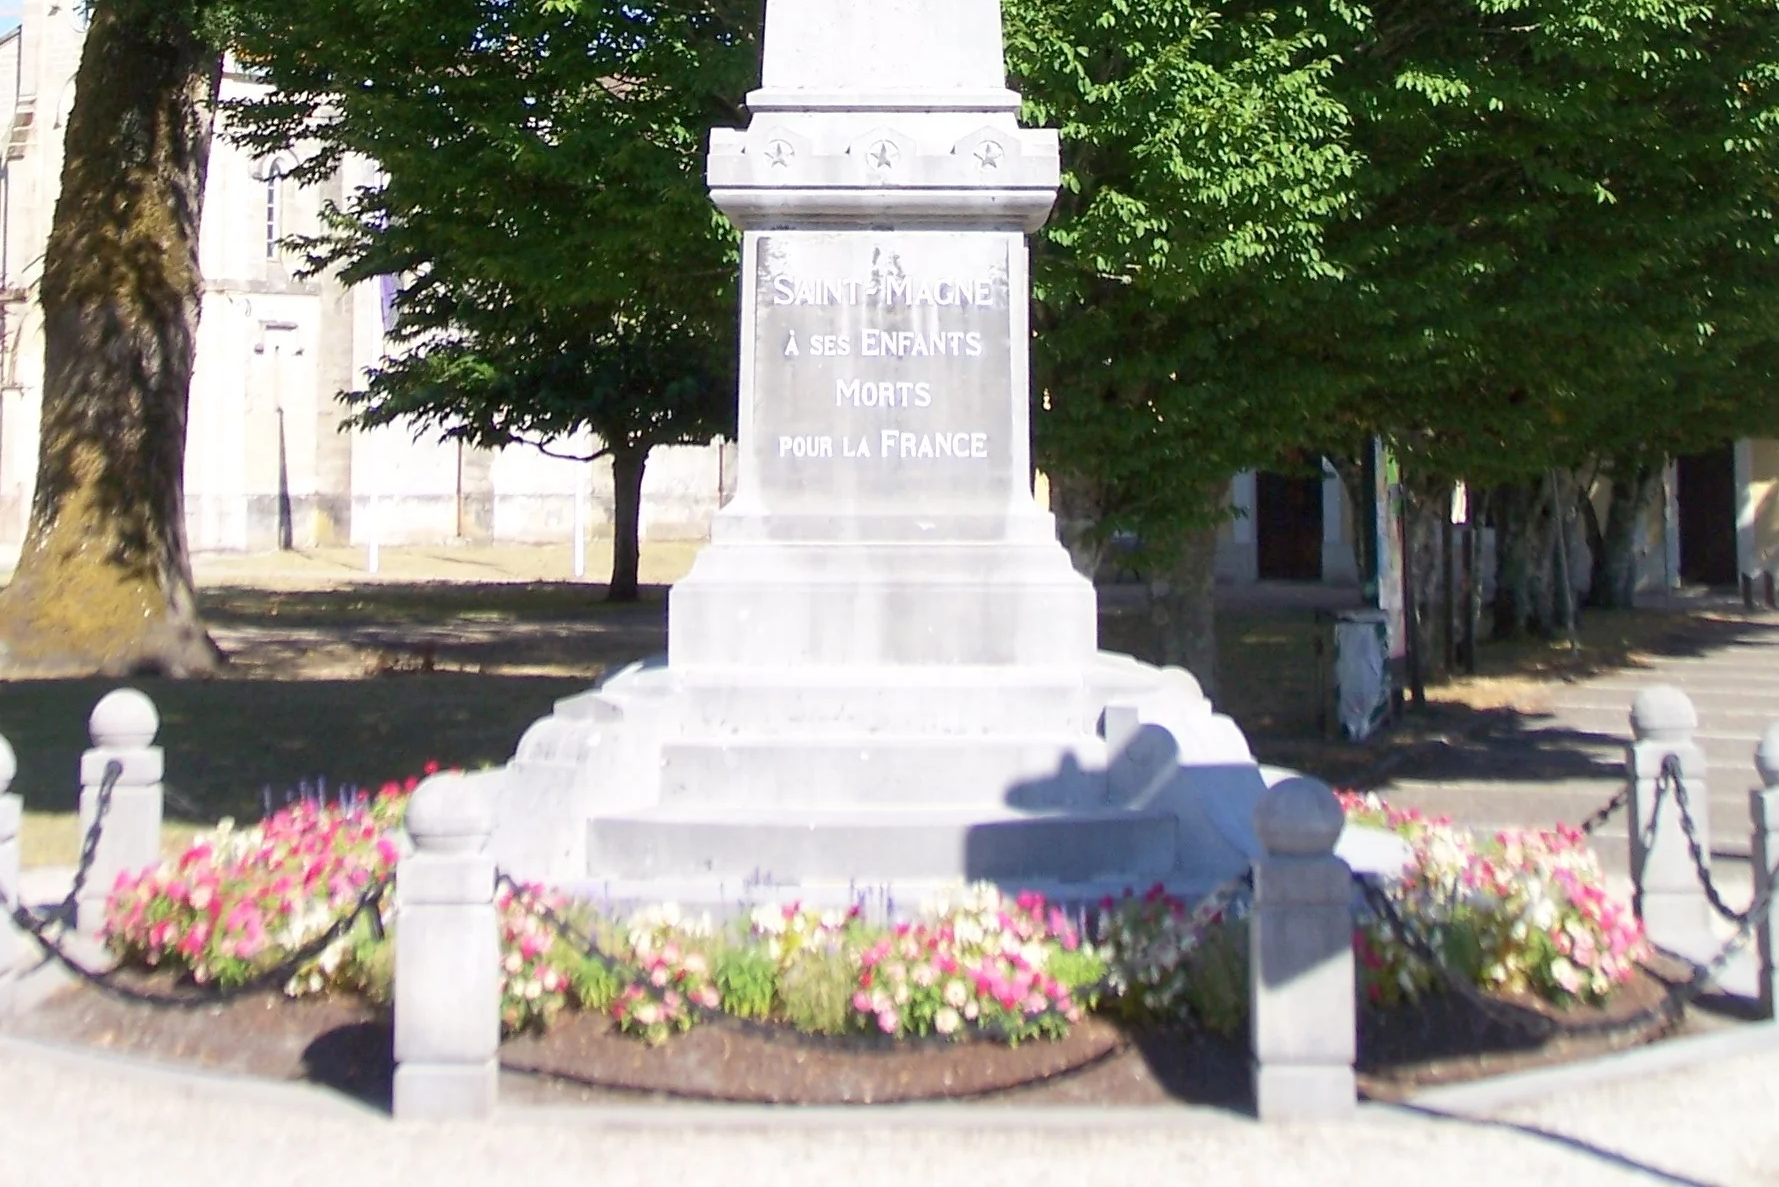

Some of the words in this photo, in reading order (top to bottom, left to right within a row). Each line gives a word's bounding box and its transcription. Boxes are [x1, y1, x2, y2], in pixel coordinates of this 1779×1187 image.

[773, 275, 994, 306] SAINT-MAGNE
[809, 334, 851, 356] SES
[861, 328, 982, 356] ENFANTS
[836, 378, 932, 407] MORTS
[779, 435, 833, 458] POUR
[843, 436, 871, 458] LA
[880, 429, 988, 458] FRANCE
